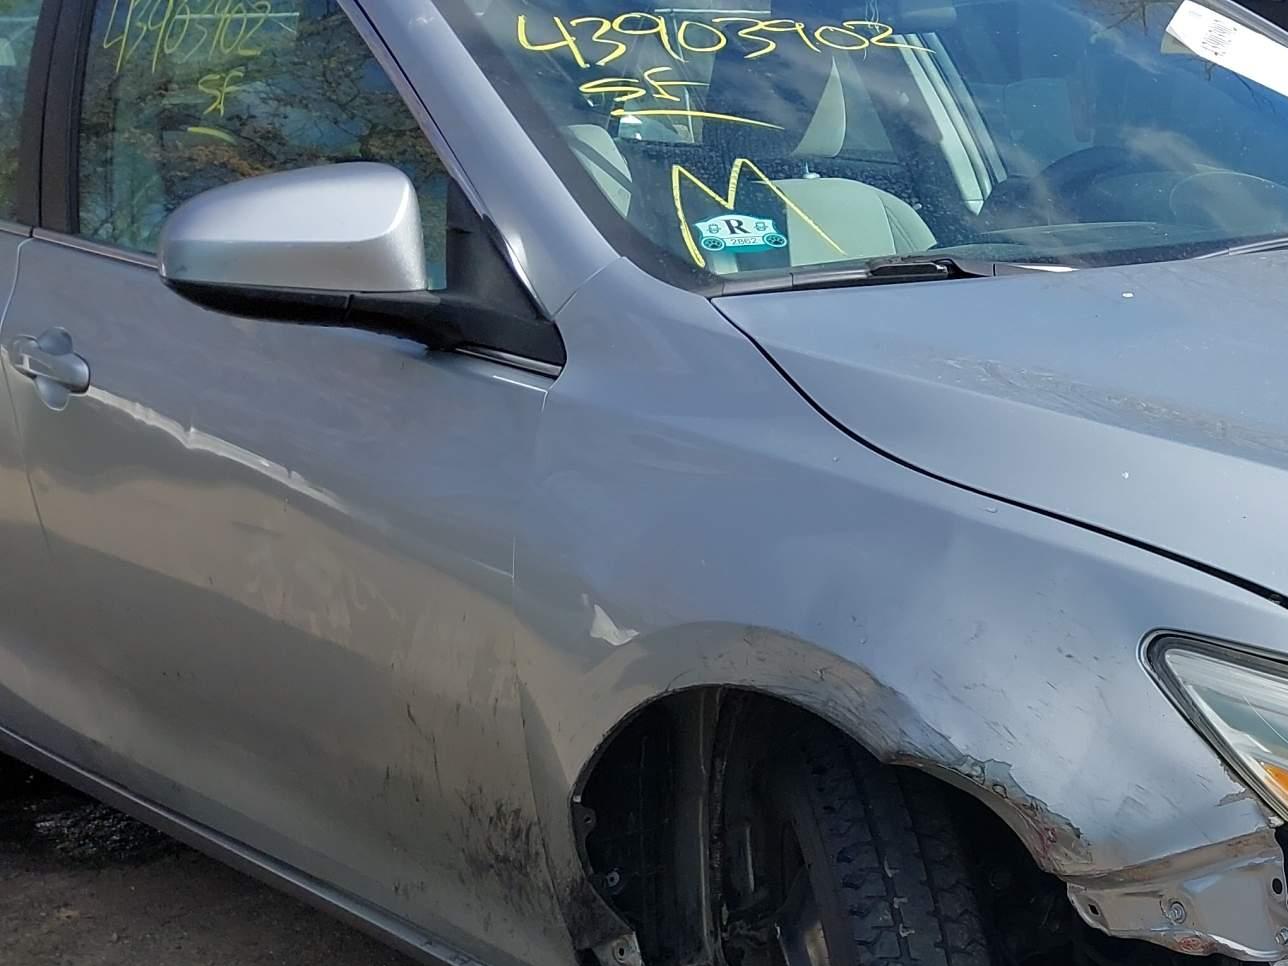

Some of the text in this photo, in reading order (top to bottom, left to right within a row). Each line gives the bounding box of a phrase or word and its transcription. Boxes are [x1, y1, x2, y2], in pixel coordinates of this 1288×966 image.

[517, 12, 937, 69] 43903902
[671, 157, 849, 269] M
[722, 218, 751, 235] R
